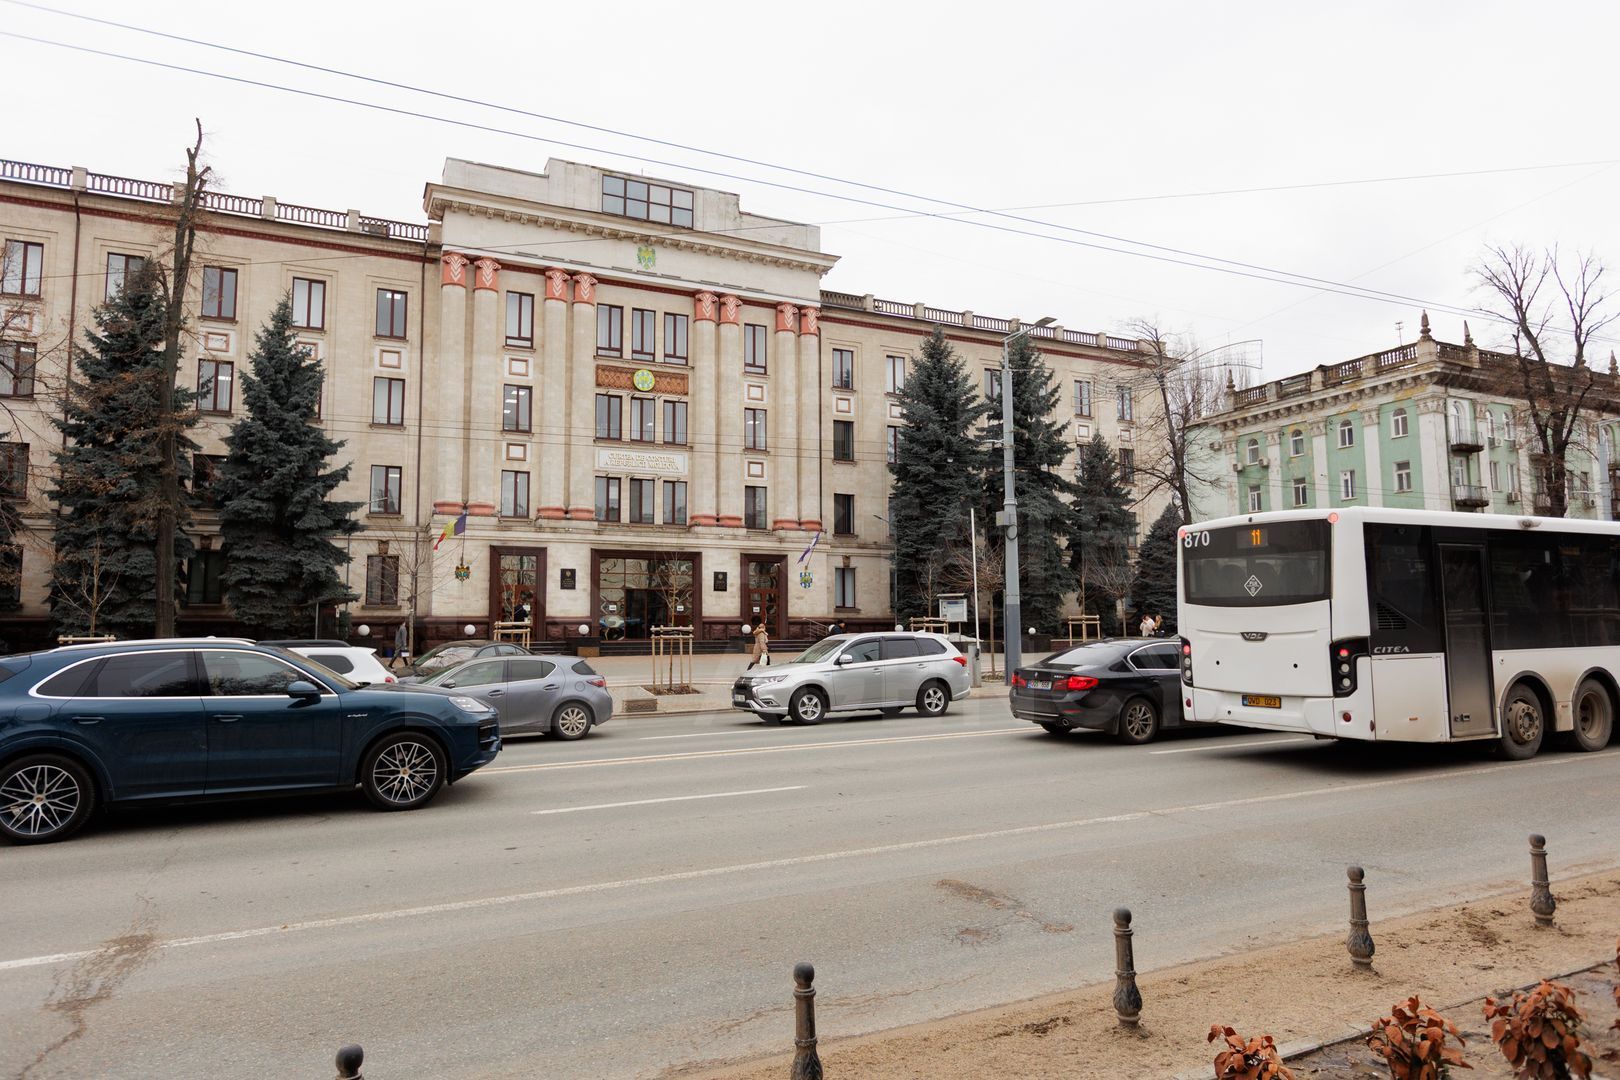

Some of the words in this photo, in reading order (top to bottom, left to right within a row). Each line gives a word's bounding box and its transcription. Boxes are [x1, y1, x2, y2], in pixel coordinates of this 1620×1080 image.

[1184, 530, 1210, 548] 870
[1252, 529, 1260, 545] 11
[1374, 646, 1410, 654] CITEA
